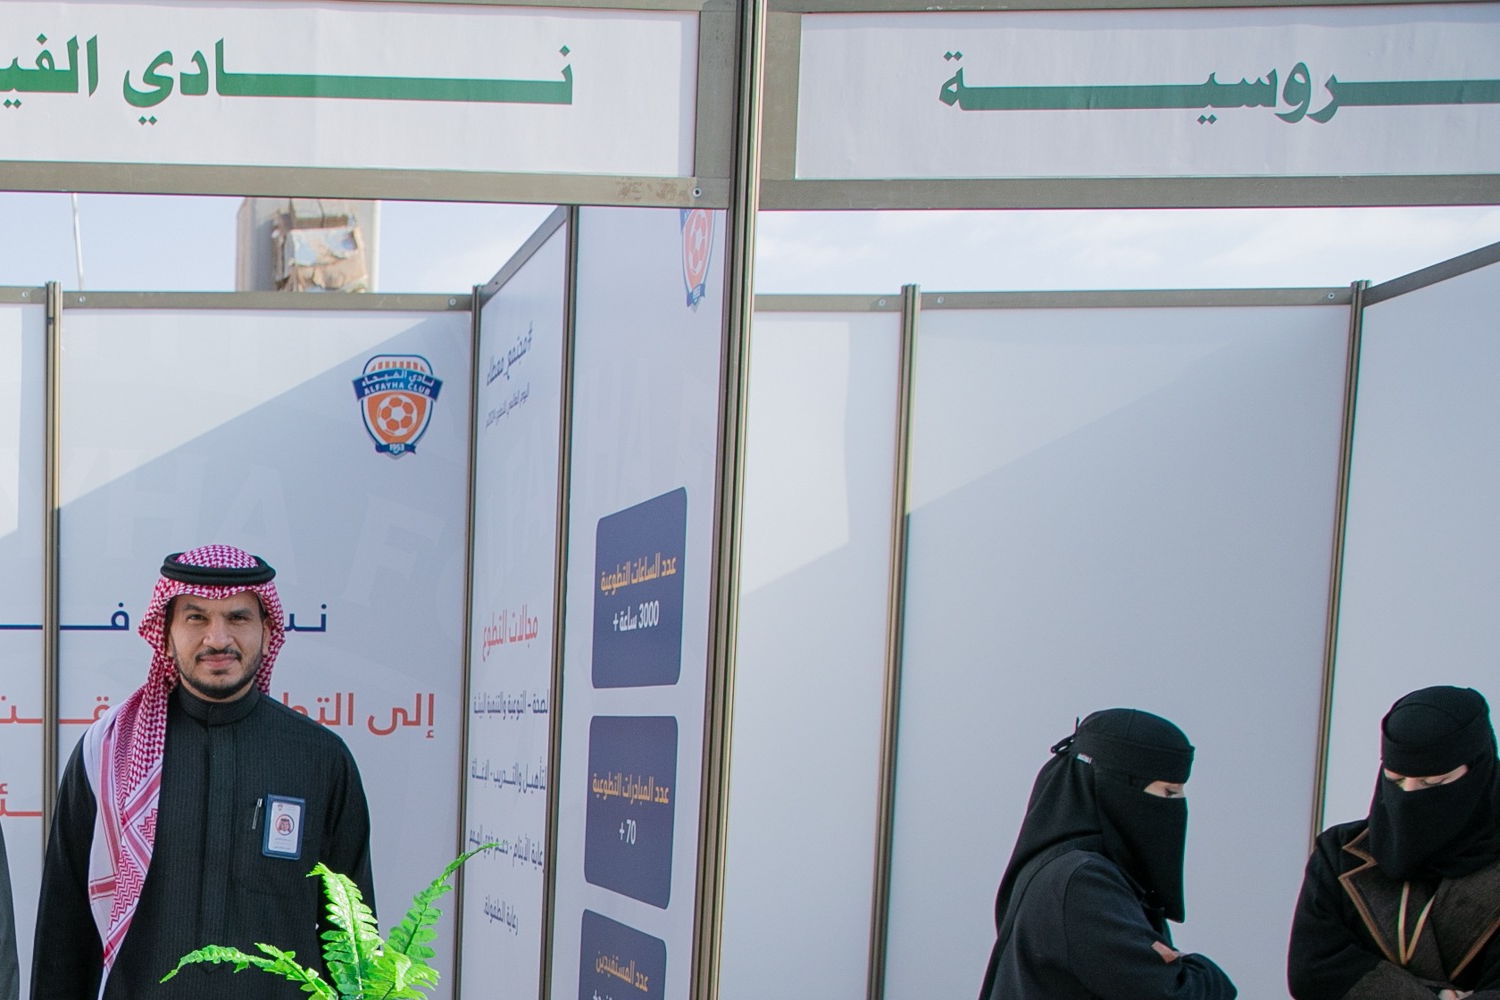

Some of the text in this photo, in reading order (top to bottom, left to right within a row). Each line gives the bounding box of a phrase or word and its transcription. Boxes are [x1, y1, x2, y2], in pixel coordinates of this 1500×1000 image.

[121, 36, 574, 127] نادي
[937, 50, 1500, 125] روسية
[600, 551, 677, 596] عدد الساعات التطوعية
[482, 603, 539, 663] مجالات التطوع
[619, 606, 638, 632] ساعة
[638, 599, 660, 629] 3000
[367, 690, 436, 739] إلى
[592, 771, 669, 805] عدد المبادرات التطوعية
[595, 951, 649, 992] عدد المستفيدين
